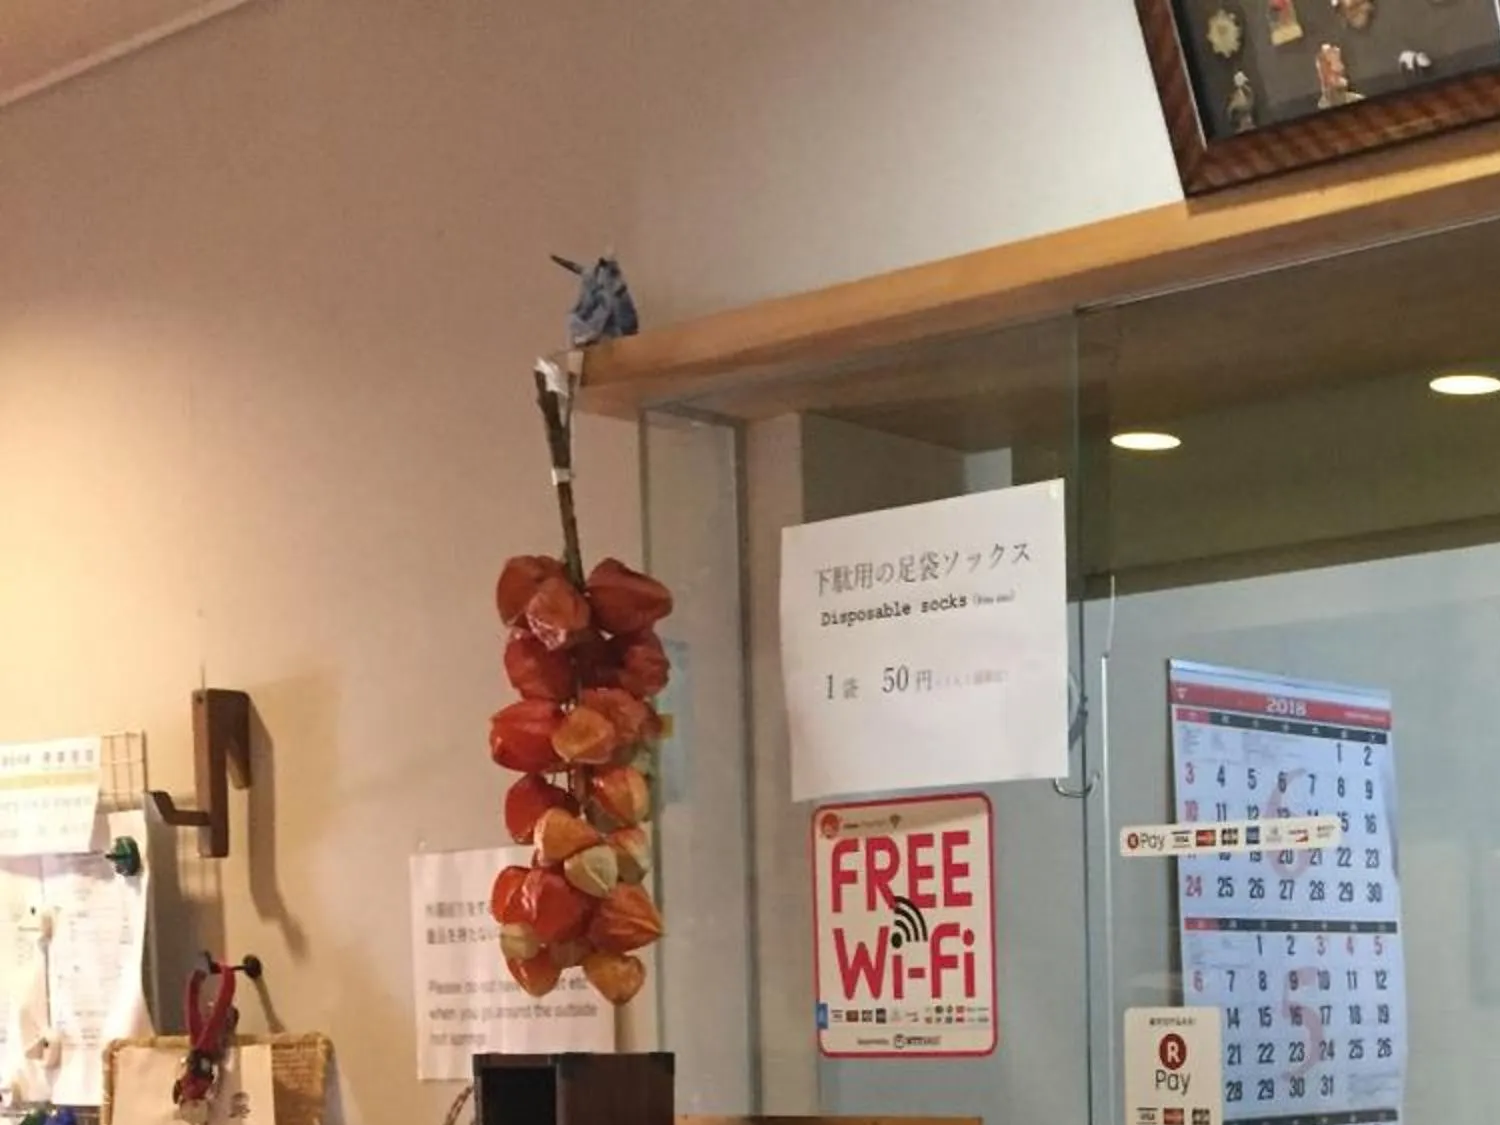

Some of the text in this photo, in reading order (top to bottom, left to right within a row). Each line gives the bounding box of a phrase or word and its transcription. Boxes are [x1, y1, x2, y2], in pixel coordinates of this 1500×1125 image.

[815, 541, 1032, 597] 下駄用の足袋ソックス
[820, 602, 912, 628] Disposable
[921, 592, 968, 613] socks
[1265, 699, 1307, 718] 2018
[1337, 742, 1374, 767] 1 2
[1185, 762, 1373, 800] 3 4 5 6 7 8 9
[1216, 802, 1227, 823] 11
[1364, 814, 1377, 834] 16
[1140, 831, 1166, 850] Pay
[831, 830, 973, 913] FREE
[1336, 847, 1350, 867] 22
[1365, 849, 1379, 869] 23
[1185, 875, 1382, 903] 24 25 26 27 28 29 30
[1257, 935, 1263, 955] 1
[1286, 935, 1296, 956] 2
[1317, 935, 1326, 956] 3
[1375, 935, 1383, 956] 5
[833, 922, 976, 1000] Wi-Fi
[1227, 970, 1235, 992] 7
[1258, 970, 1267, 991] 8
[1289, 970, 1298, 991] 9
[1317, 970, 1331, 991] 10
[1347, 970, 1358, 991] 11
[1375, 969, 1387, 990] 12
[1226, 1004, 1390, 1028] 14 15 16 17 18 19
[1227, 1038, 1392, 1065] 21 22 23 24 25 26
[1155, 1069, 1190, 1097] Pay
[1225, 1075, 1334, 1102] 28 29 30 31
